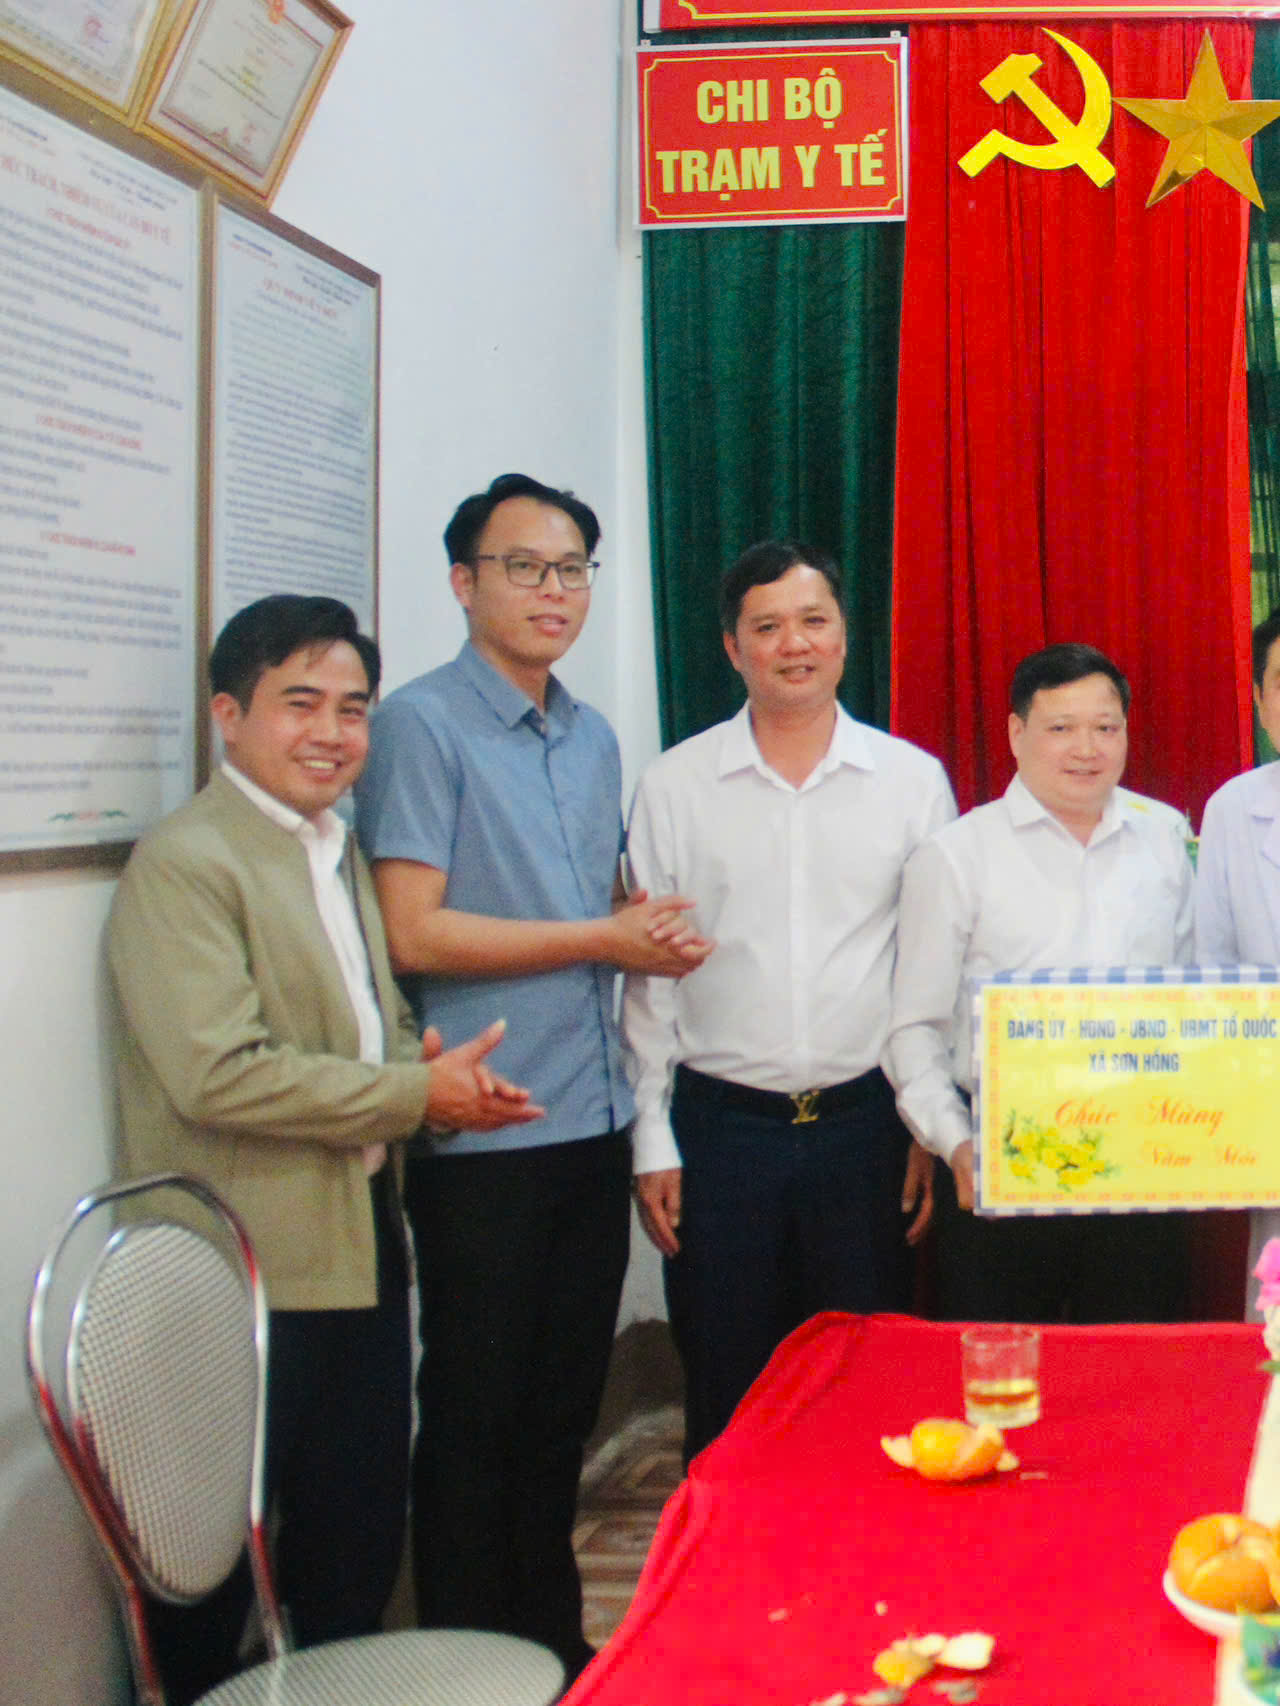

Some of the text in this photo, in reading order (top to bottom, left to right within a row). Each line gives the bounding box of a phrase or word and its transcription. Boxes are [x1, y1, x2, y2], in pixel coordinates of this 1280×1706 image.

[697, 67, 843, 129] CHI BỘ
[656, 128, 888, 201] TRẠM Y TẾ
